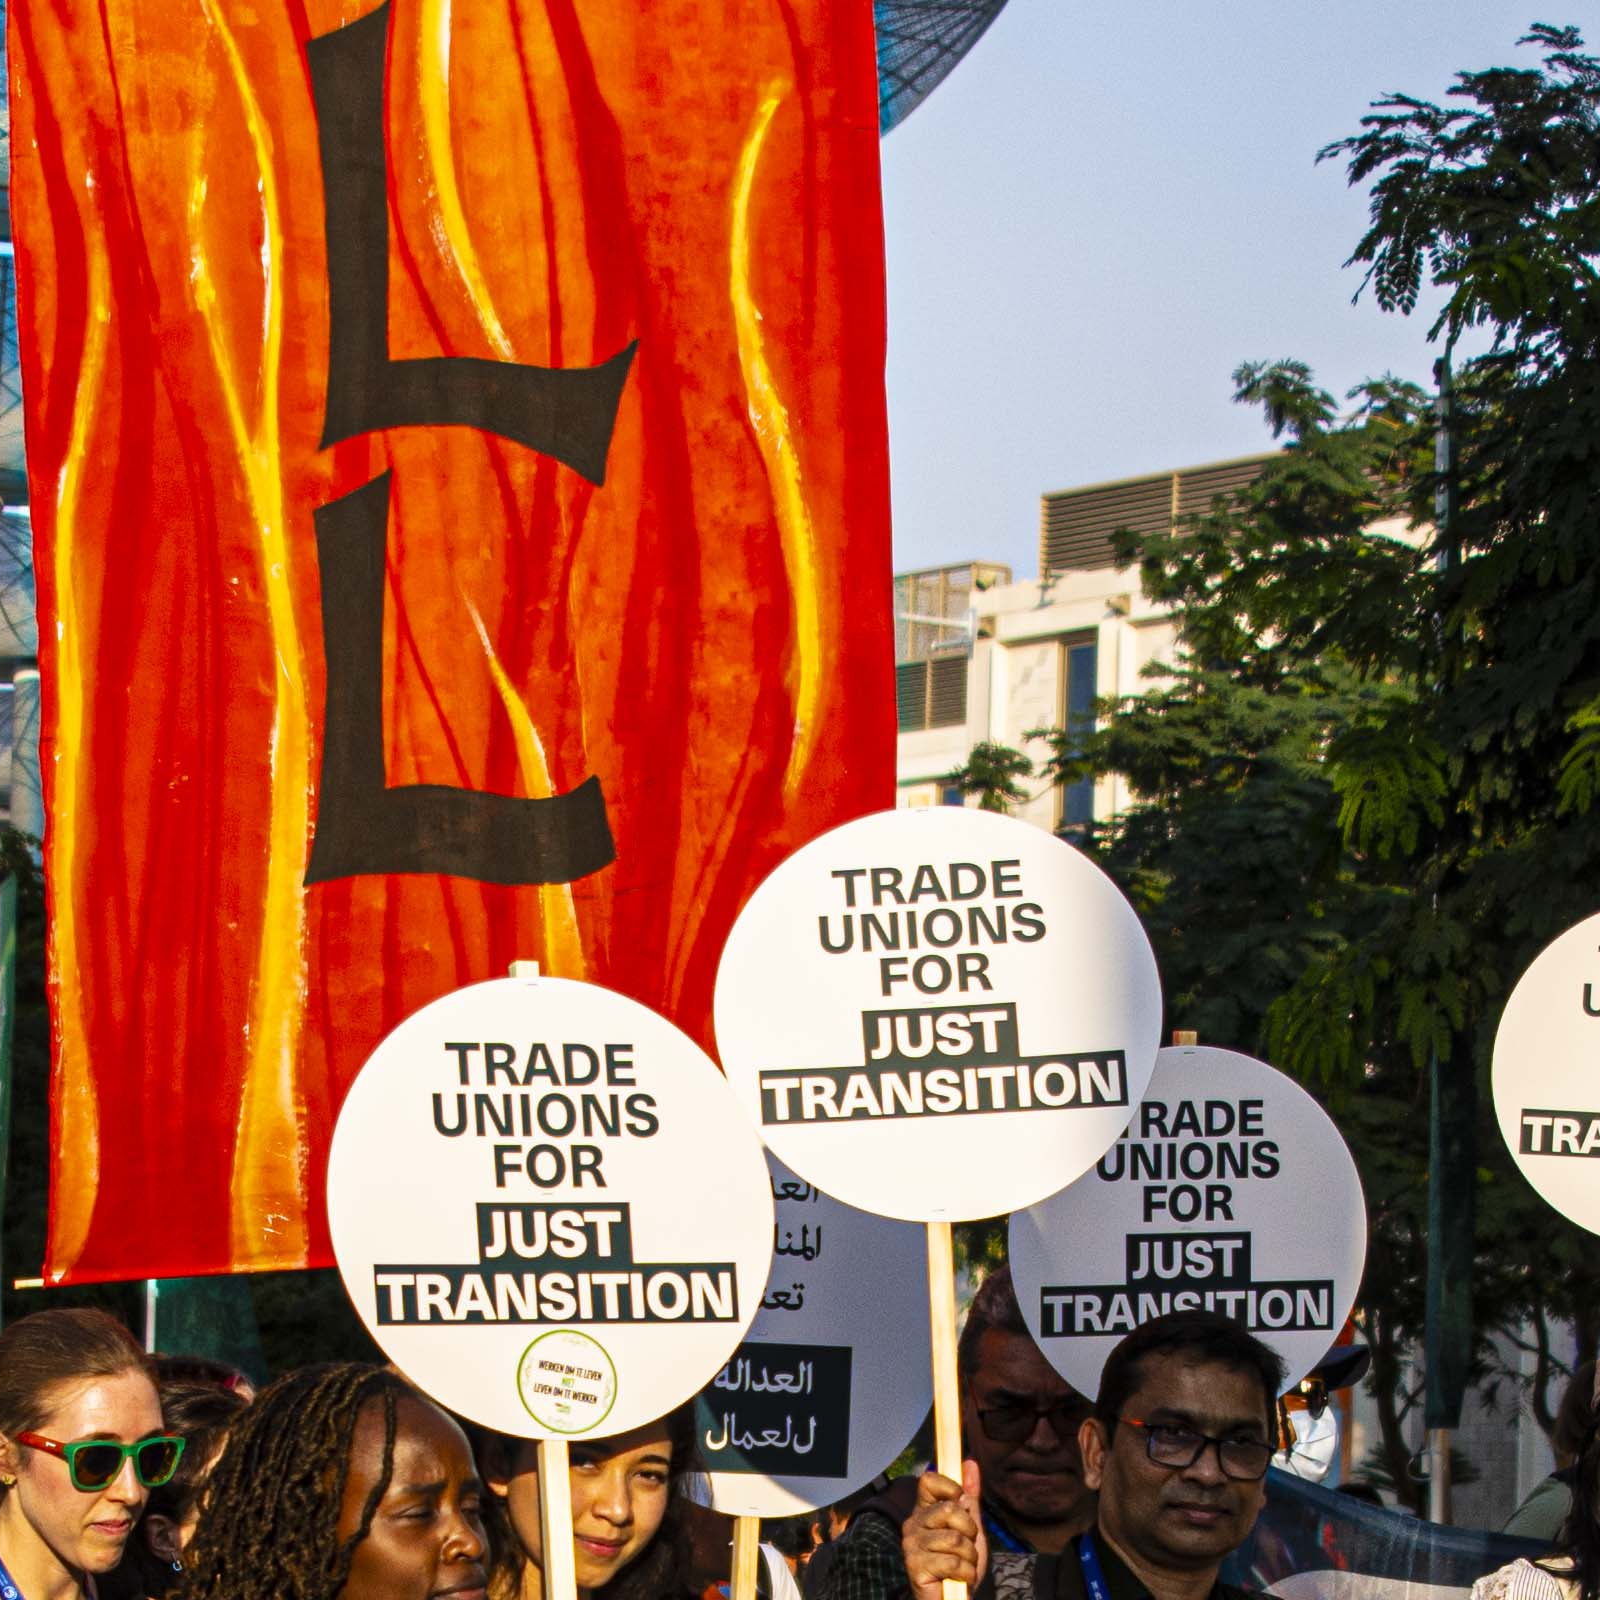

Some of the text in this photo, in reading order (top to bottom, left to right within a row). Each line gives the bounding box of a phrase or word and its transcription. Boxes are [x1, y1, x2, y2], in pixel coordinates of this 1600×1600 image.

[832, 859, 1024, 908] TRADE
[818, 902, 1047, 954] UNIONS
[879, 952, 994, 997] FOR
[870, 1010, 1009, 1061] JUST
[445, 1042, 637, 1087] TRADE
[761, 1060, 1123, 1122] TRANSITION
[431, 1093, 660, 1137] UNIONS
[493, 1144, 608, 1188] FOR
[1097, 1141, 1280, 1182] UNIONS
[1142, 1184, 1234, 1223] FOR
[484, 1210, 622, 1258] JUST
[1132, 1238, 1243, 1280] JUST
[375, 1271, 735, 1321] TRANSITION
